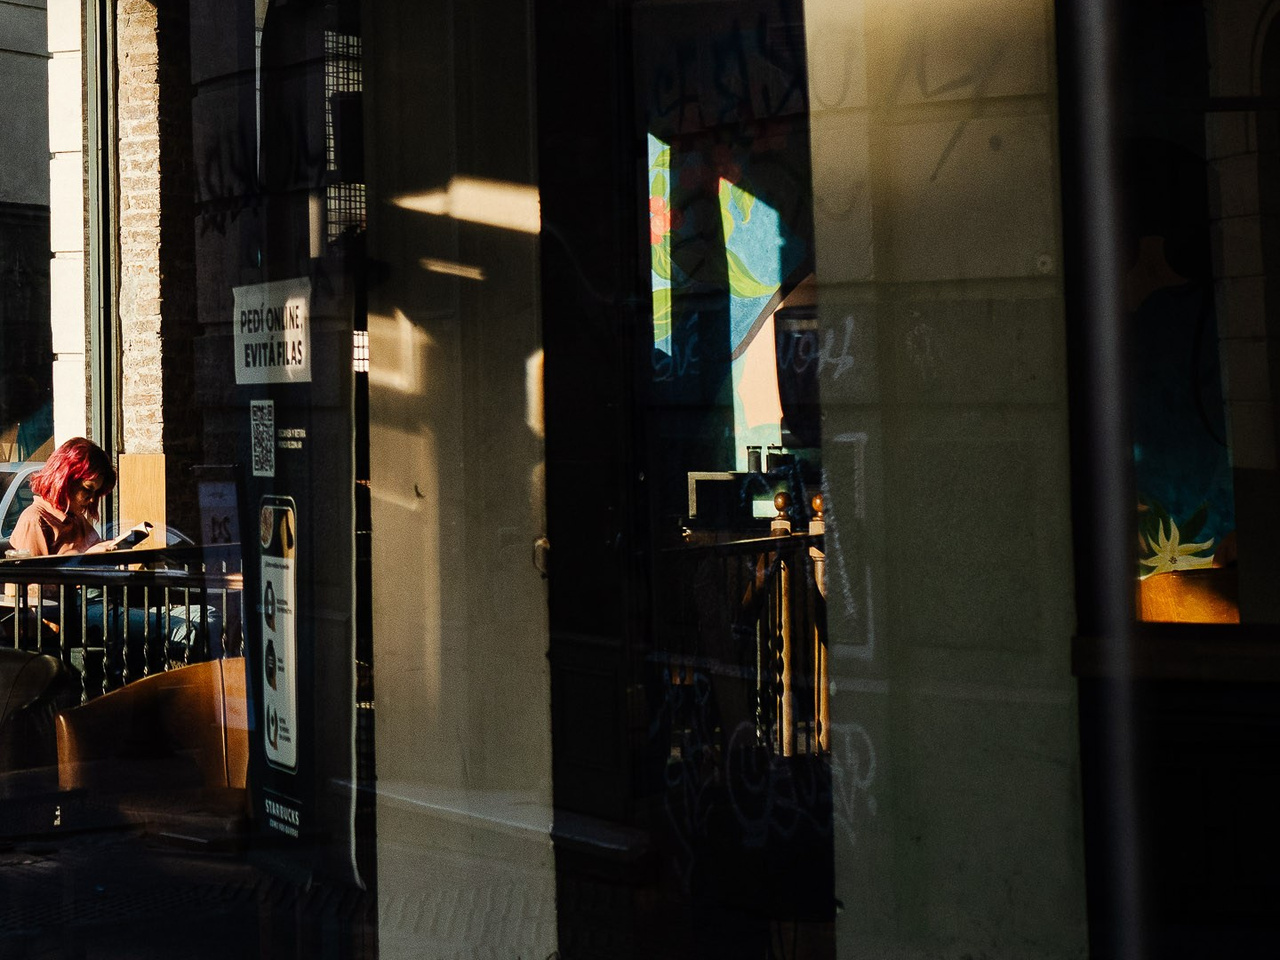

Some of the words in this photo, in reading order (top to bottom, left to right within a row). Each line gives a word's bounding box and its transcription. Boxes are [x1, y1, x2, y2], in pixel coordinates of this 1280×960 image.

[240, 303, 264, 334] PEDÍ
[244, 337, 275, 368] EVITÁ
[277, 340, 303, 367] FILAS
